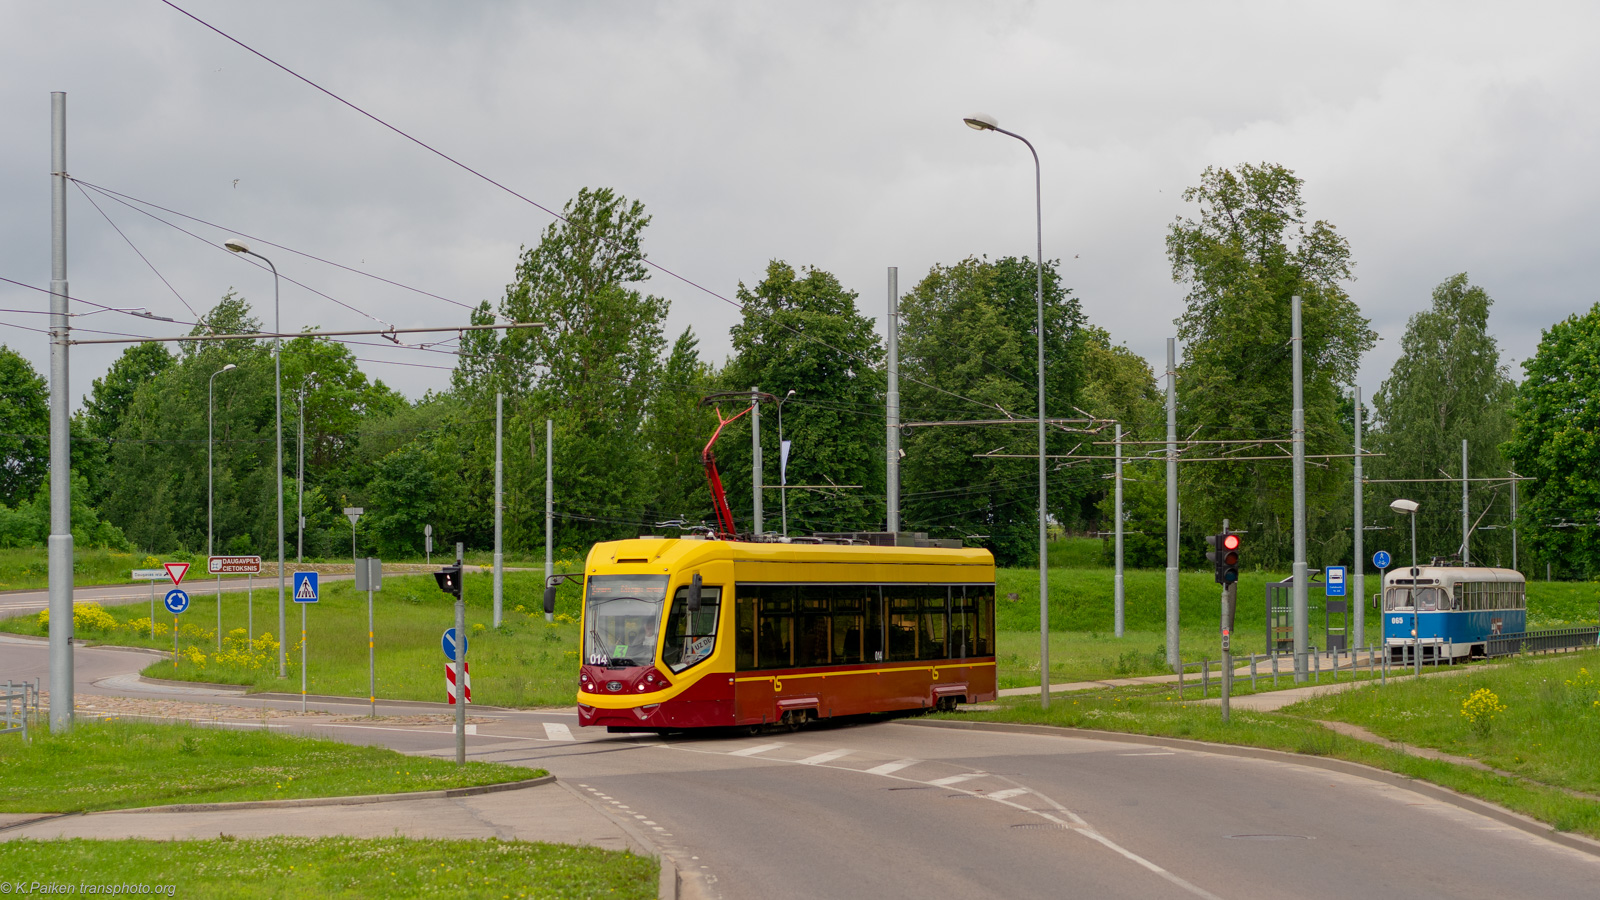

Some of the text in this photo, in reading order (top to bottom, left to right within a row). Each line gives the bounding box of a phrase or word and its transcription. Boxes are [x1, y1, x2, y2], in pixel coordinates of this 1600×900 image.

[694, 642, 704, 650] UZ
[590, 654, 607, 664] 014
[875, 651, 883, 661] 014
